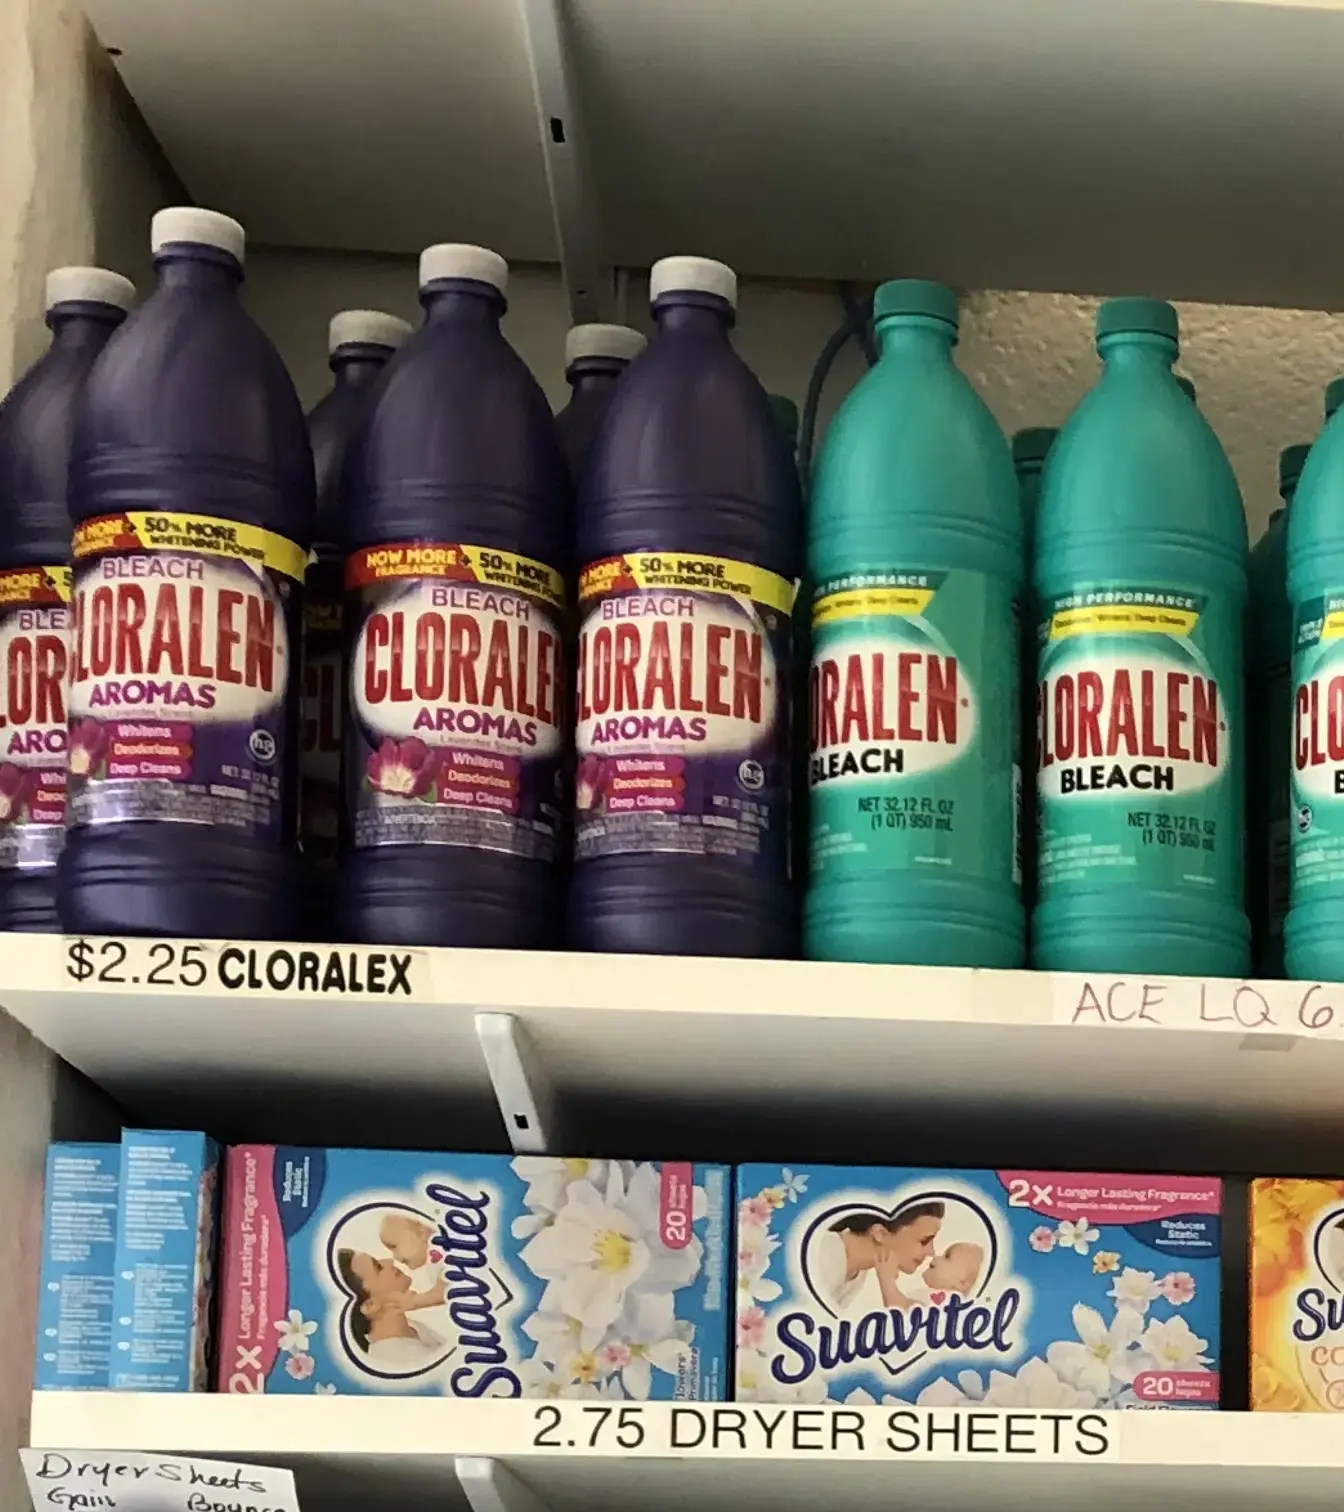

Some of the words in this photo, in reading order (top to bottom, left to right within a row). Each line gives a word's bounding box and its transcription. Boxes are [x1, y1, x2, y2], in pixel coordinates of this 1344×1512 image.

[103, 558, 204, 580] BLEACH
[432, 588, 529, 620] BLEACH
[89, 680, 216, 708] AROMAS
[413, 708, 537, 746] AROMAS
[453, 752, 504, 772] Whitens
[1061, 765, 1174, 793] BLEACH
[66, 941, 208, 988] $2.25
[218, 948, 412, 995] CLORALEX
[1072, 981, 1165, 1025] ACE
[1201, 984, 1278, 1028] LQ
[1057, 1187, 1100, 1200] Longer
[1102, 1188, 1147, 1202] Lasting
[426, 1183, 521, 1398] Suavitel
[770, 1288, 1020, 1385] Suavitel
[1143, 1377, 1173, 1395] 20
[533, 1406, 646, 1450] 2.75
[669, 1408, 866, 1453] DRYER
[886, 1409, 1110, 1456] SHEETS
[36, 1453, 148, 1486] Dryer
[48, 1487, 116, 1510] Gain
